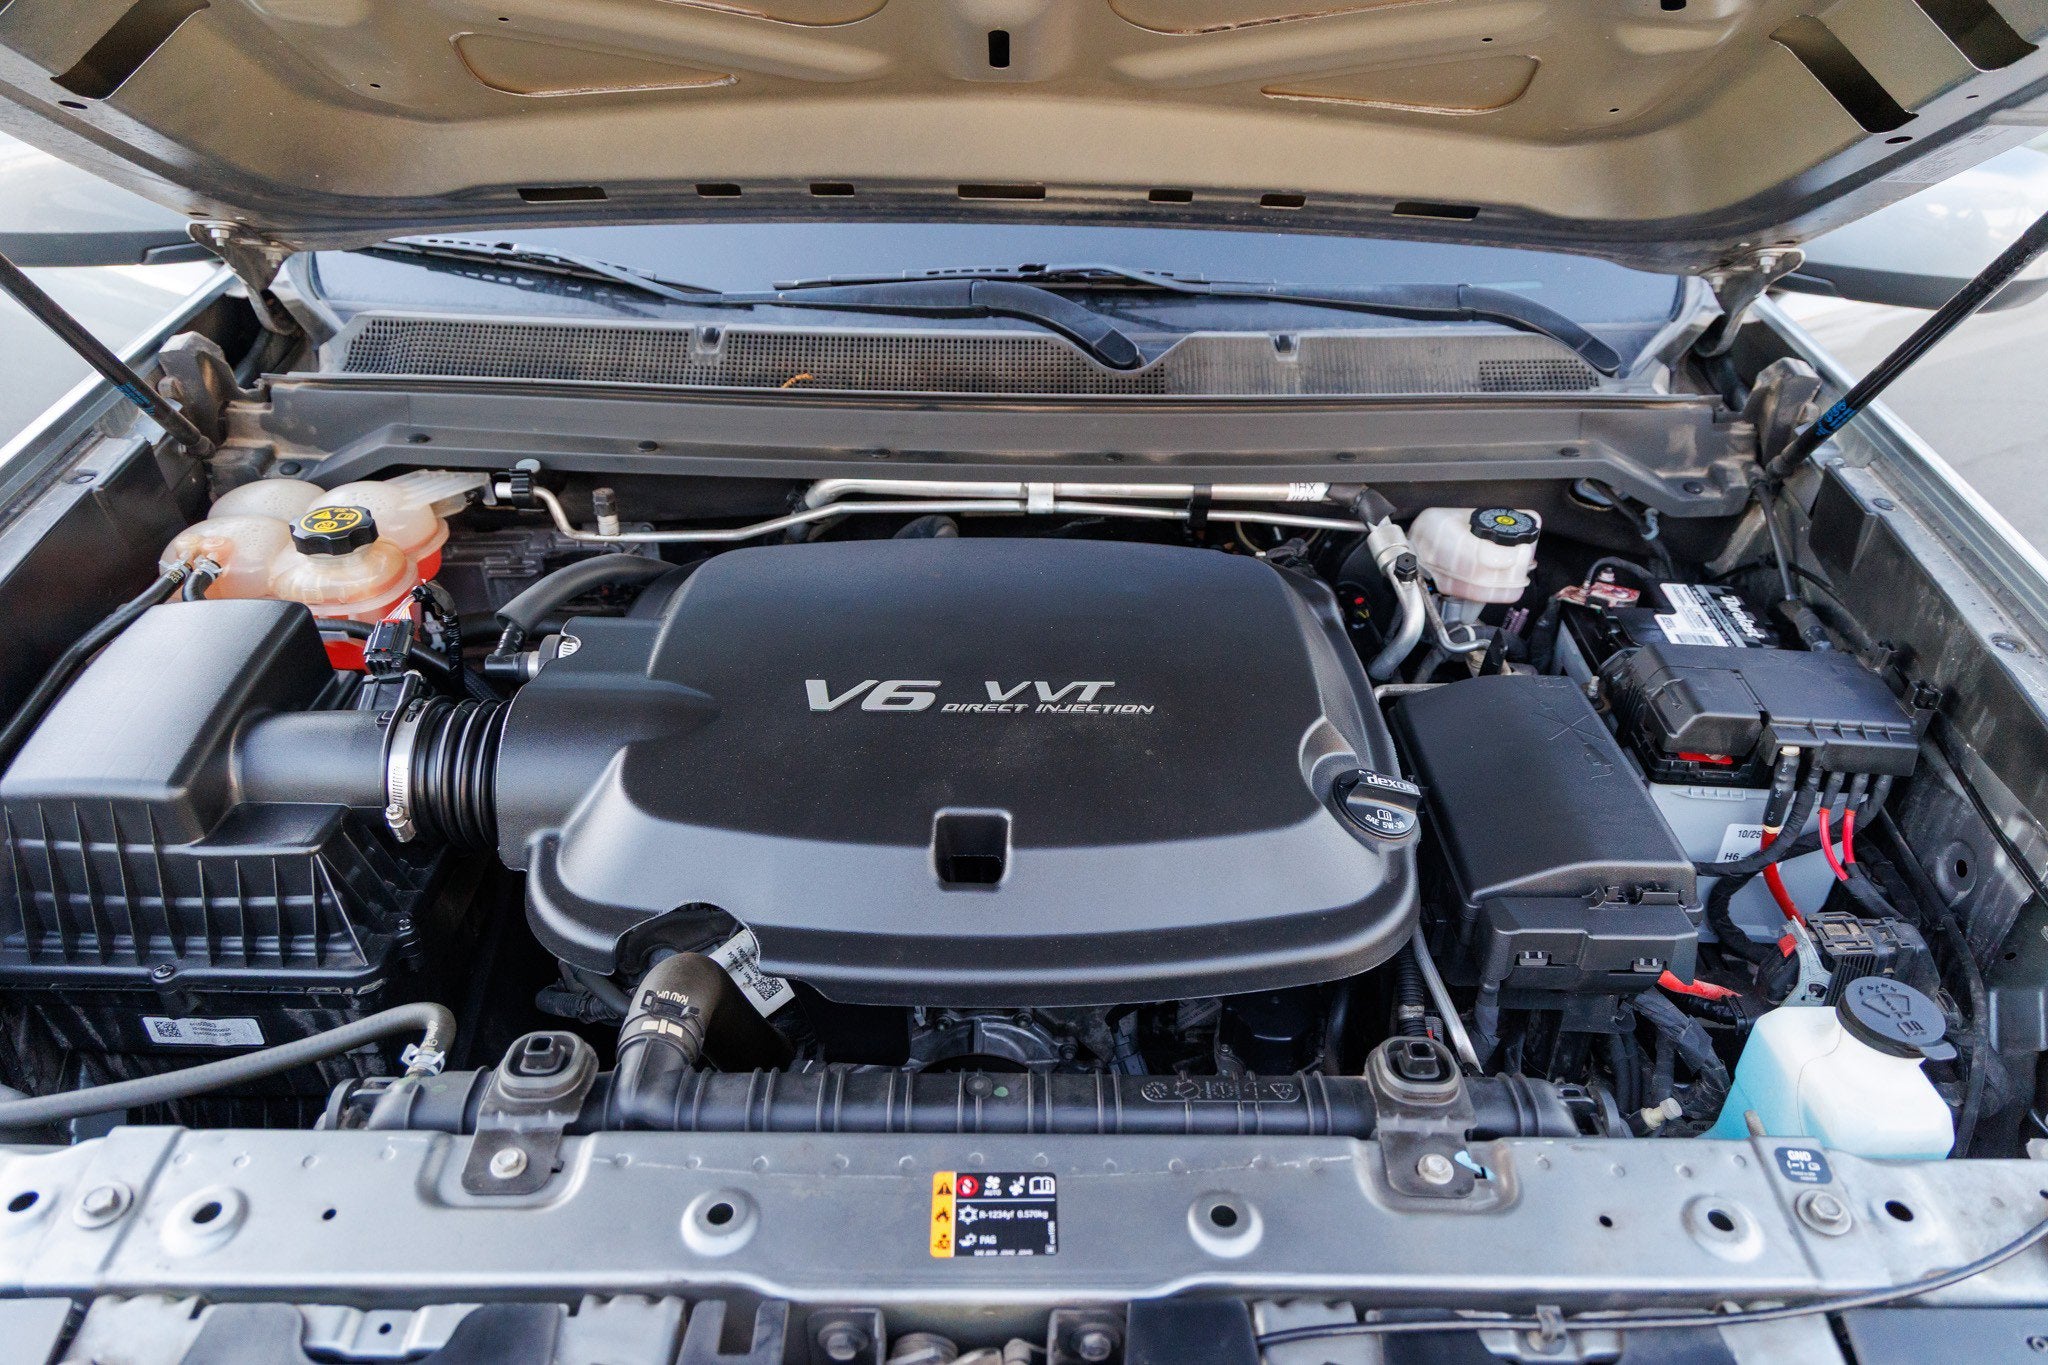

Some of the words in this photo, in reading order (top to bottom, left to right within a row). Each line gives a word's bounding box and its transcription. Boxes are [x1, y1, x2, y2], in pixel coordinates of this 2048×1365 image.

[1719, 595, 1766, 639] Duralast
[805, 679, 942, 713] V6
[985, 681, 1115, 703] VVT
[941, 703, 1030, 715] DIRECT
[1035, 703, 1155, 715] INJECTION
[1366, 773, 1416, 793] dexos
[1364, 813, 1380, 826] SAE
[1737, 830, 1762, 839] 10/25
[1723, 852, 1740, 861] H6
[1786, 1149, 1812, 1162] GND
[979, 1234, 998, 1245] PAG
